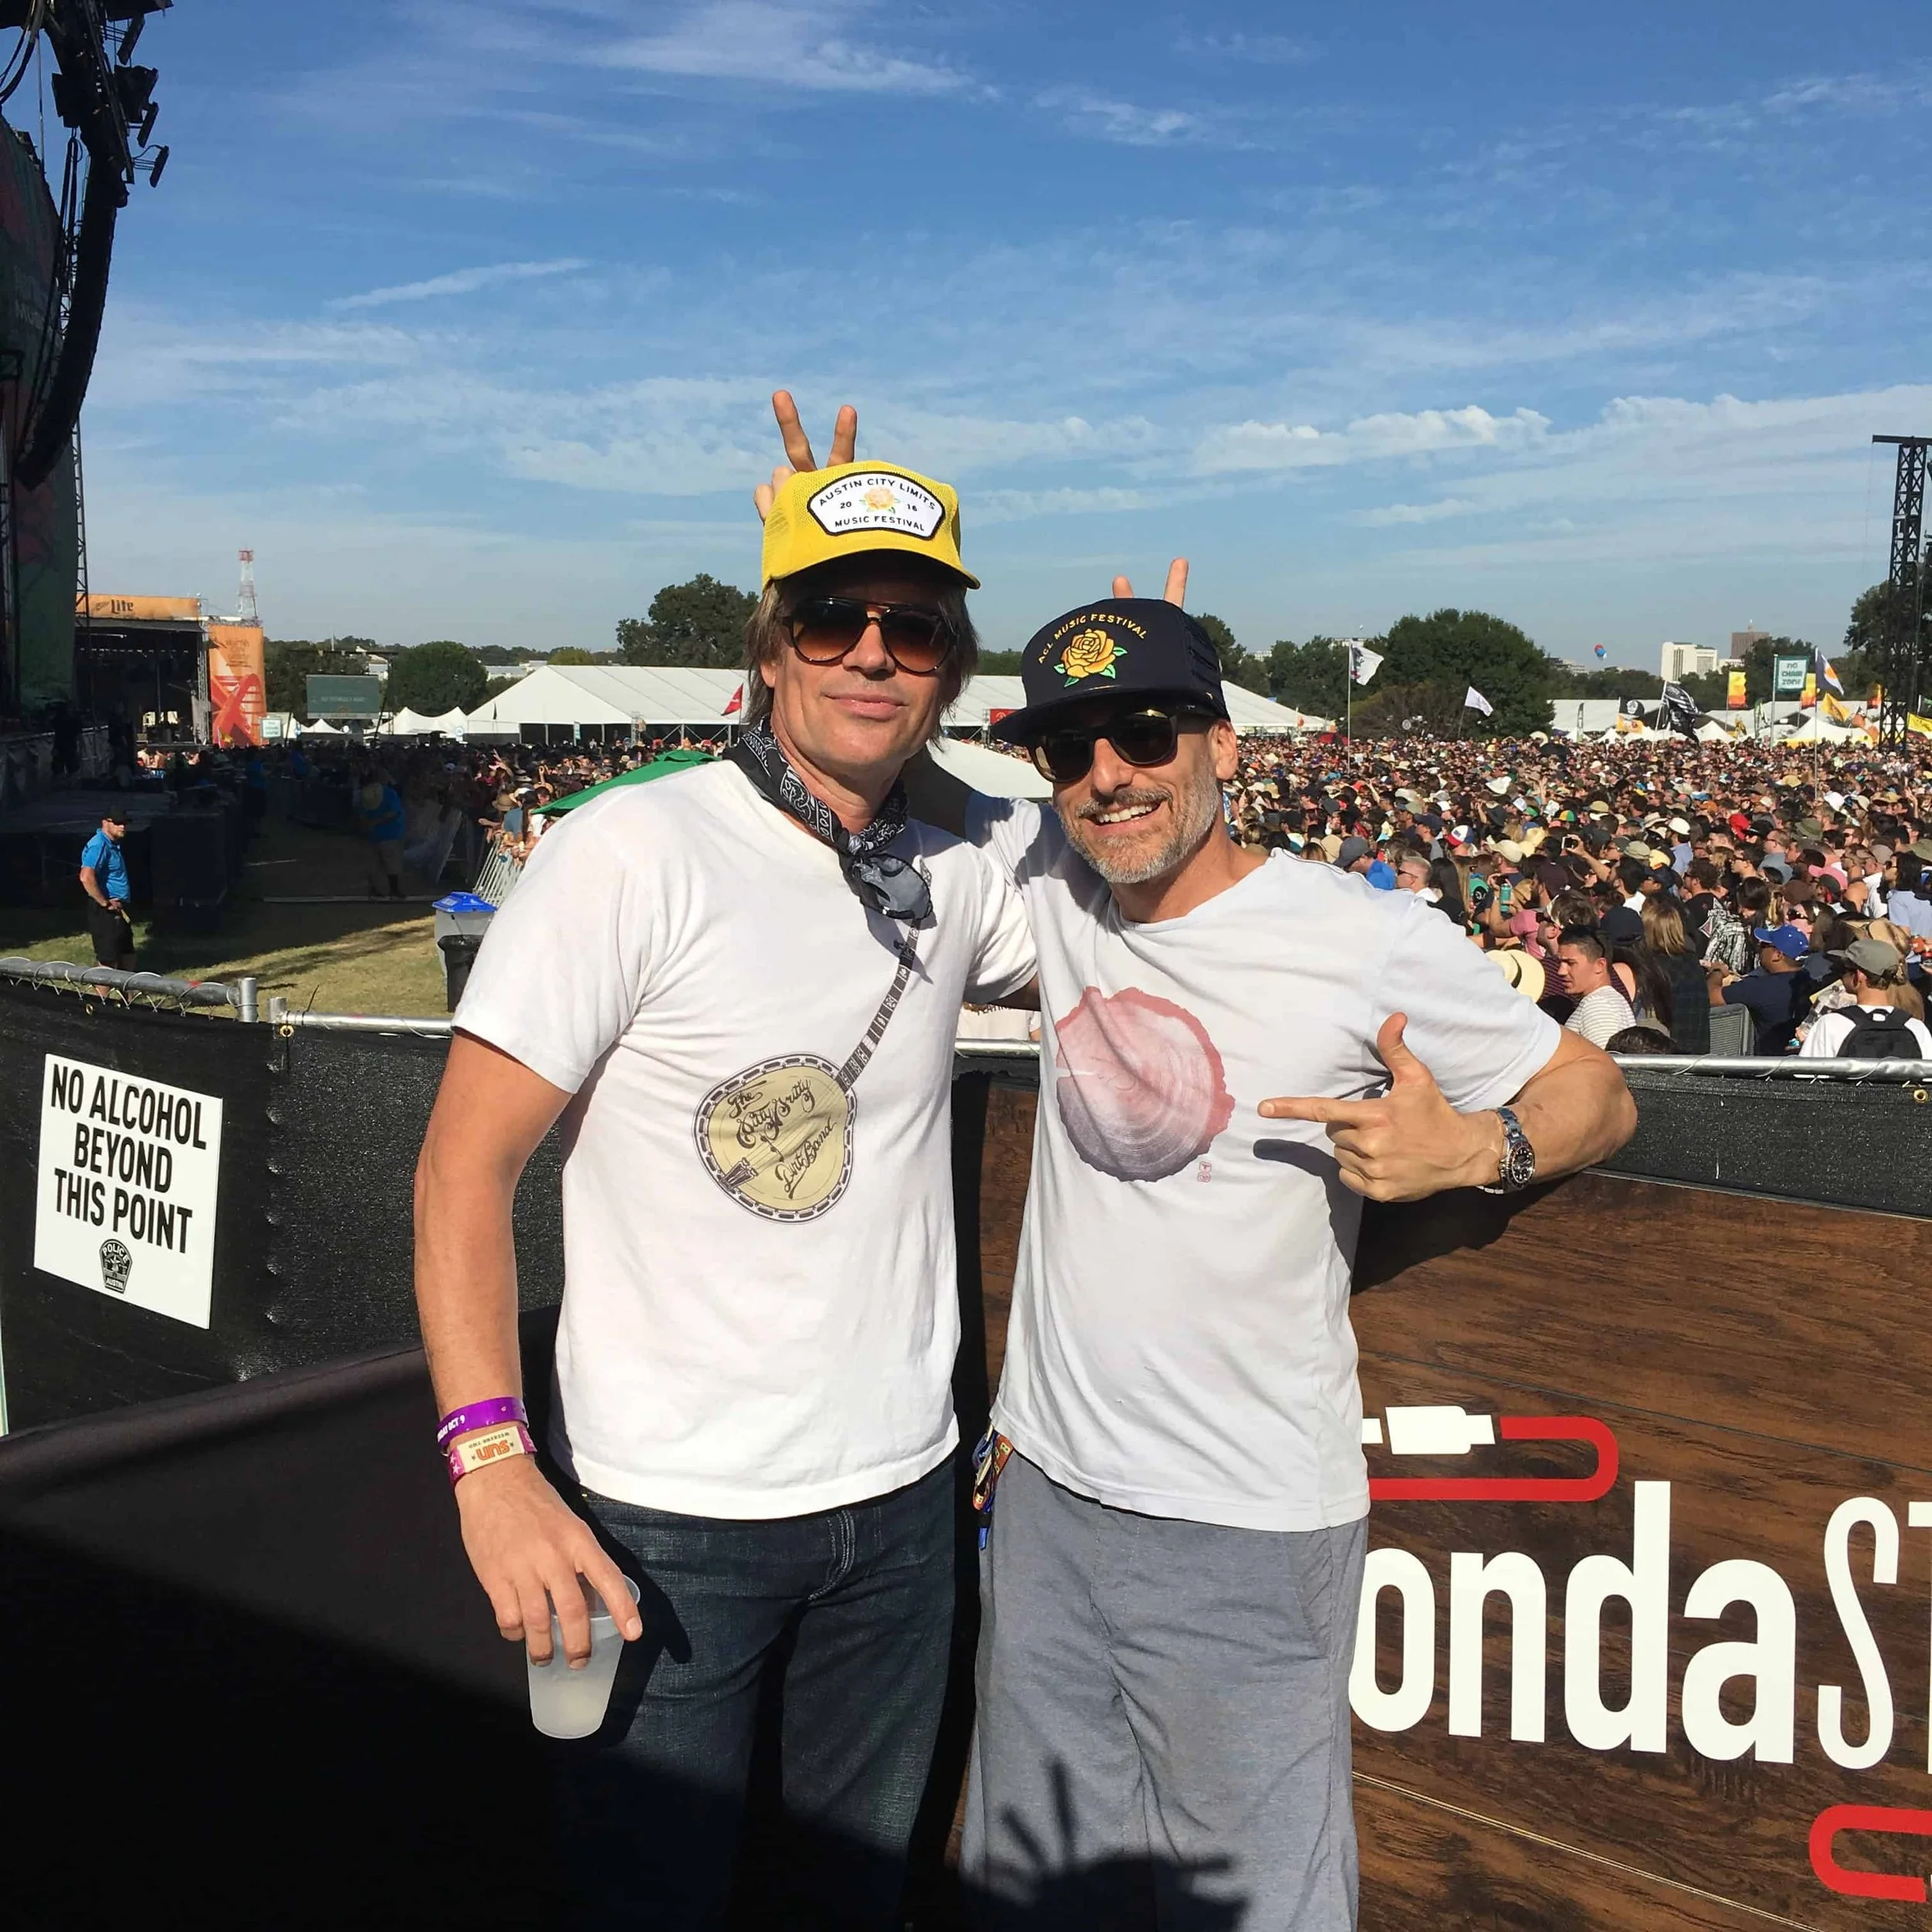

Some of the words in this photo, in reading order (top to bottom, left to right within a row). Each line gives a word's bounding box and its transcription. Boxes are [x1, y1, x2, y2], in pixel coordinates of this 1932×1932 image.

[819, 479, 862, 506] AUSTIN
[867, 478, 896, 487] CITY
[900, 483, 936, 510] LIMITS
[840, 501, 852, 509] 20
[906, 503, 918, 512] 16
[835, 515, 870, 528] MUSIC
[874, 515, 925, 532] FESTIVAL
[111, 599, 134, 614] Lite
[1039, 642, 1054, 665] ACL
[1053, 615, 1087, 641] MUSIC
[1090, 614, 1148, 640] FESTIVAL
[51, 1063, 83, 1114] NO
[89, 1075, 207, 1150] ALCOHOL
[728, 1080, 767, 1117] The
[73, 1122, 172, 1193] BEYOND
[54, 1168, 105, 1226] THIS
[112, 1187, 193, 1253] POINT
[102, 1243, 129, 1264] POLICE
[1348, 1481, 1932, 1776] ondaS
